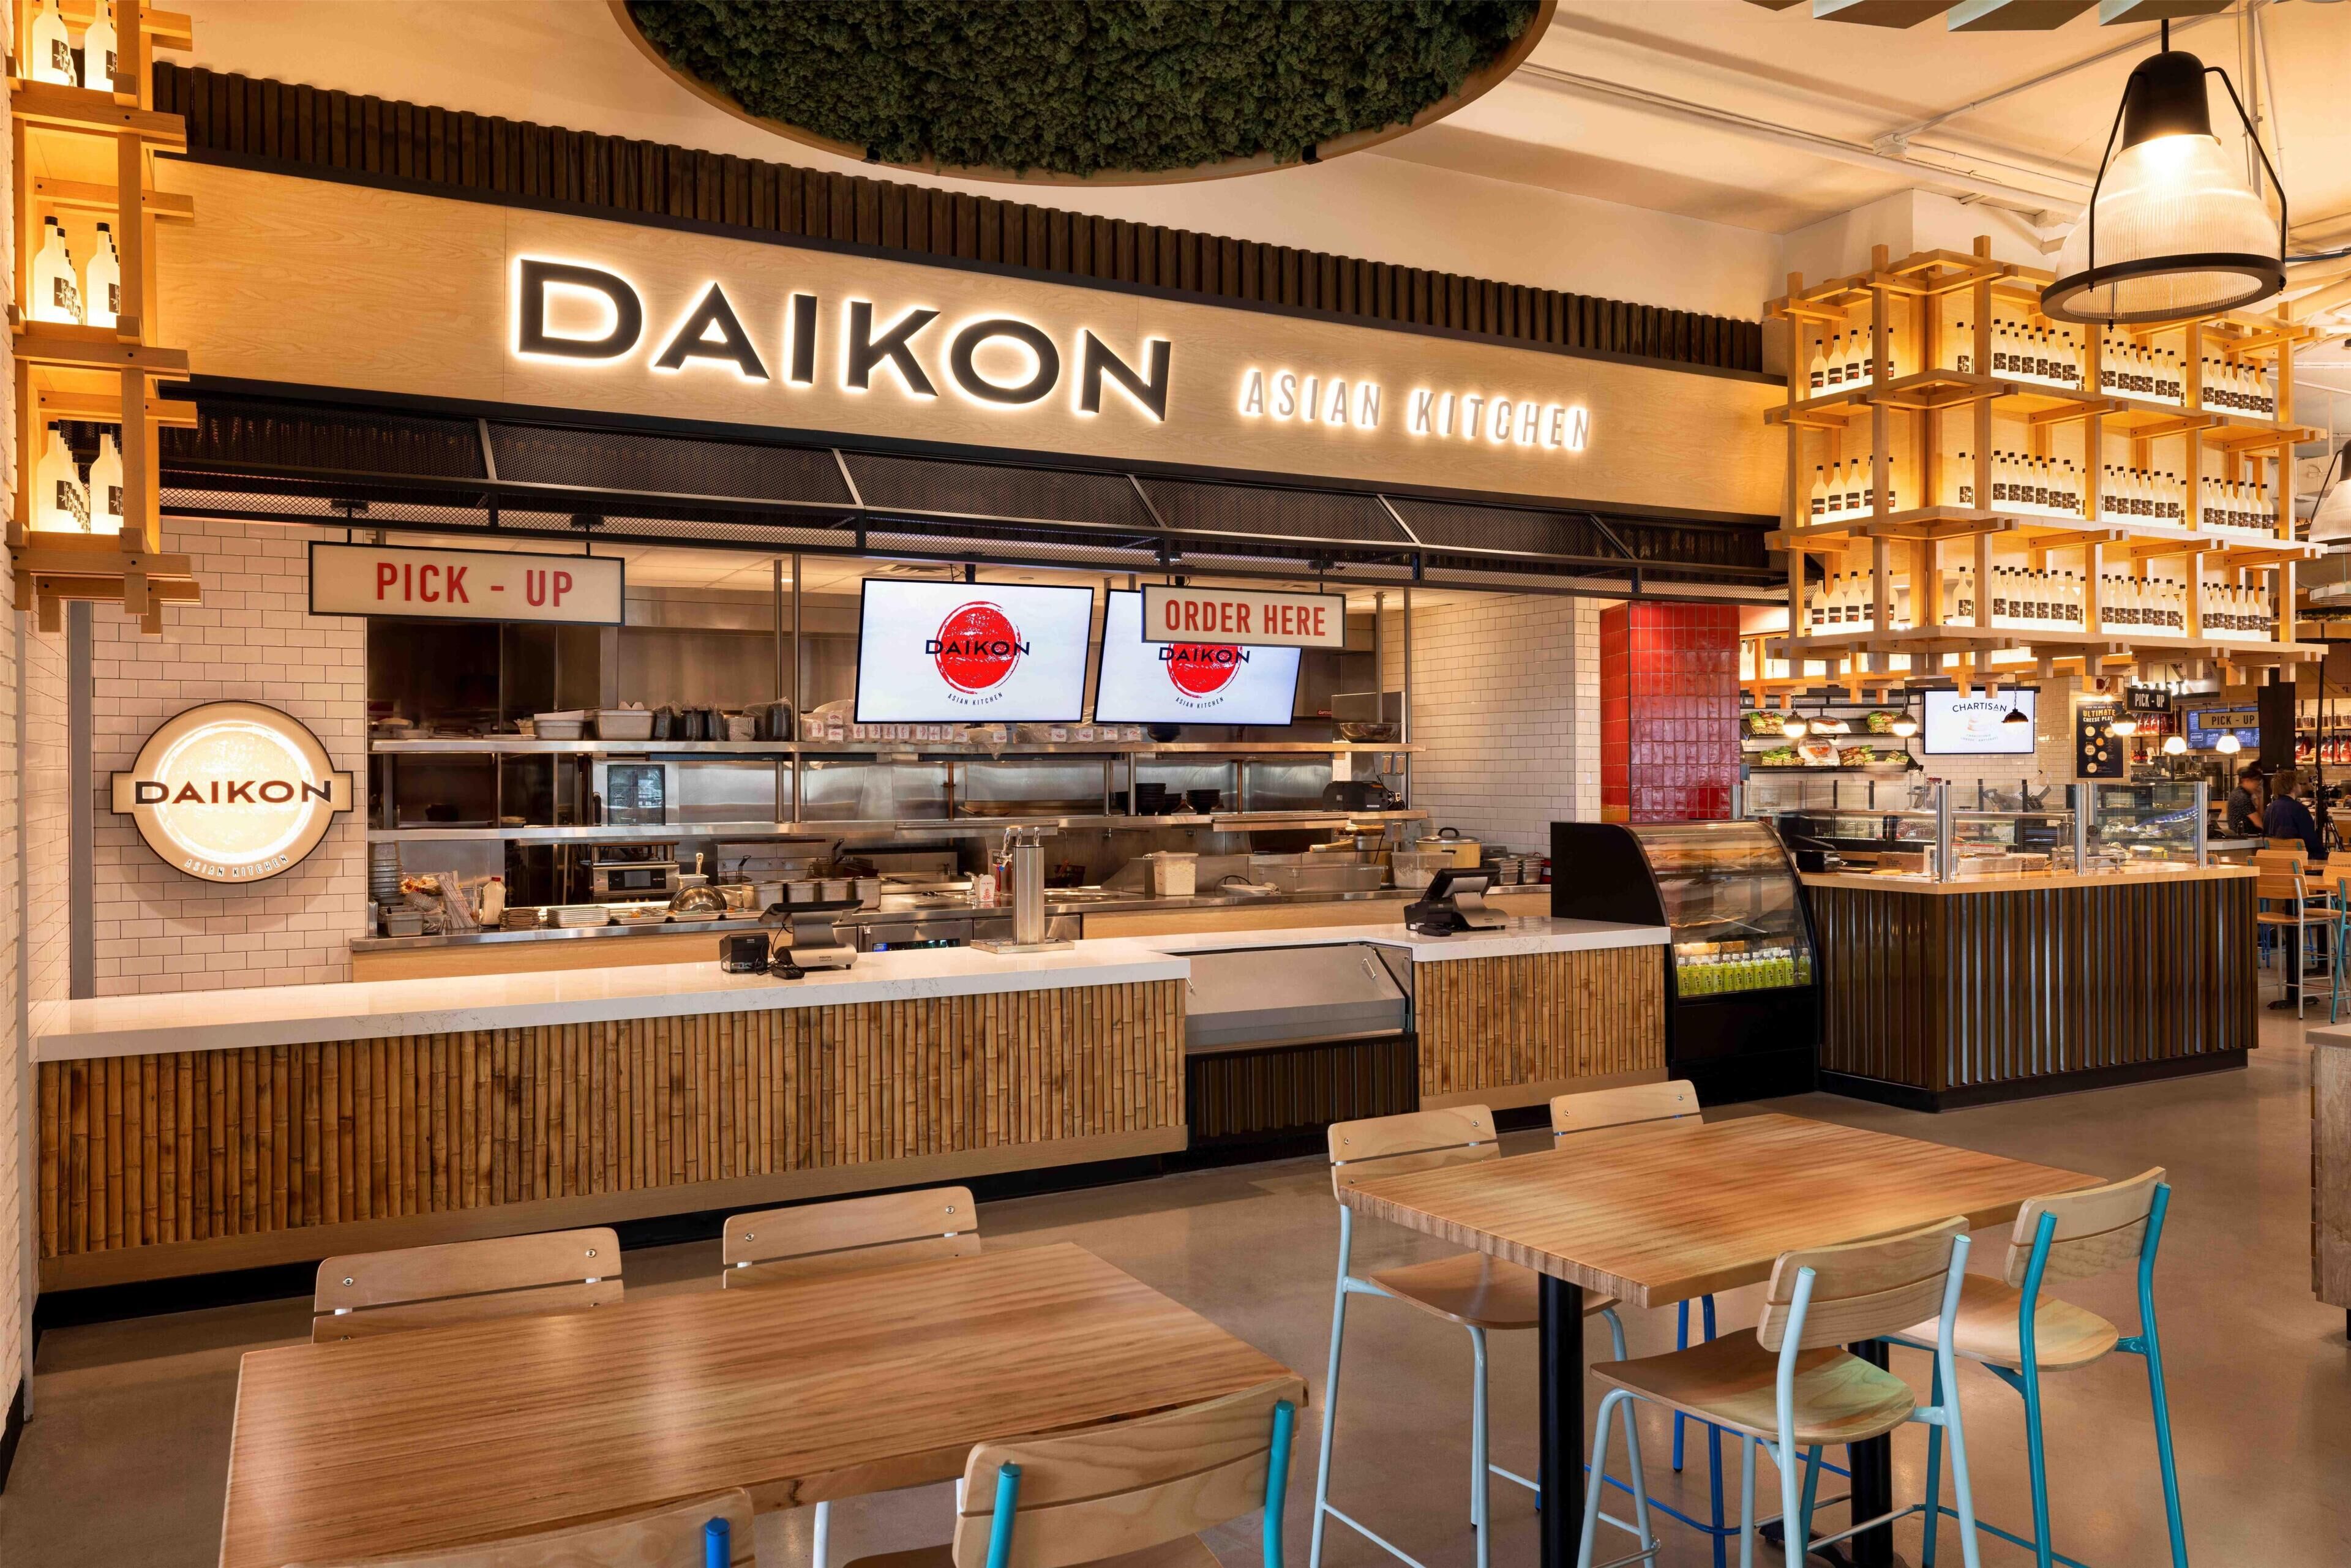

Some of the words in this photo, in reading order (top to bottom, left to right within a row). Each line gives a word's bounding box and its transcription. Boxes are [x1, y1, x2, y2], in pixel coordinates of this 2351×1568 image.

[513, 257, 1172, 421] DAIKON
[1242, 370, 1381, 427] ASIAN
[1412, 391, 1591, 449] KITCHEN
[377, 562, 470, 604] PICK
[527, 569, 572, 607] UP
[1165, 599, 1250, 634] ORDER
[1264, 605, 1326, 637] HERE
[925, 639, 1030, 656] DAIKON
[1158, 647, 1250, 664] DAIKON
[947, 692, 969, 705] ASIAN
[972, 692, 1003, 706] KITCHEN
[1175, 696, 1193, 709] ASIAN
[1196, 696, 1224, 710] KITCHEN
[1952, 703, 2007, 712] CHARTISAN
[2135, 693, 2150, 707] PICK
[2156, 694, 2165, 708] UP
[2083, 709, 2116, 718] ULTIMATE
[2211, 716, 2232, 726] PICK
[2243, 715, 2254, 724] UP
[135, 780, 331, 805] DAIKON
[185, 858, 225, 877] ASIAN
[232, 853, 289, 877] KITCHEN
